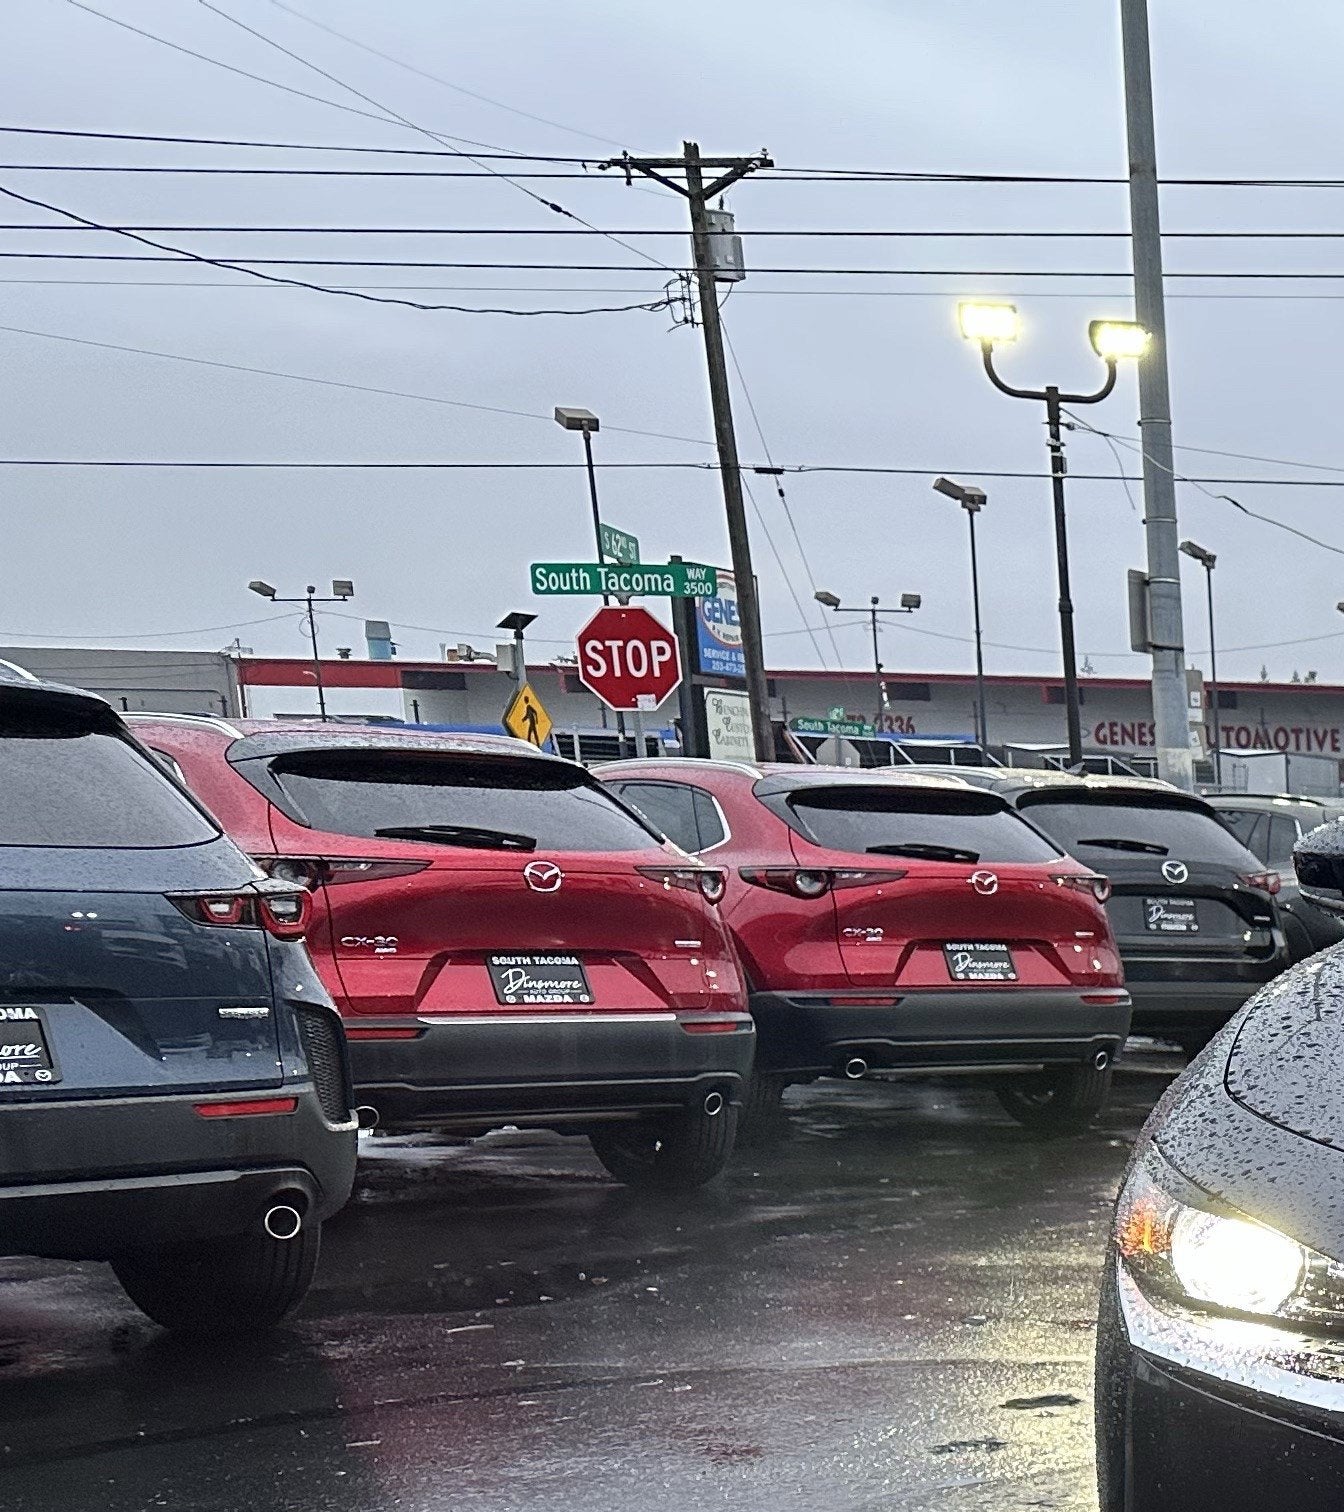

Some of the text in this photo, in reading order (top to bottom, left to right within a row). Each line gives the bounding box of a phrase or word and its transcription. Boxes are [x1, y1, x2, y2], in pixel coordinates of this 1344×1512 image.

[604, 531, 610, 550] S
[535, 567, 675, 592] South Tacoma
[686, 568, 707, 580] WAY
[683, 582, 713, 595] 3500
[585, 639, 672, 678] STOP
[1094, 721, 1156, 746] GENES
[1205, 724, 1340, 752] UTOMOTIVE
[491, 956, 579, 965] SOUTH TACOMA
[501, 967, 582, 994] Dinsmore
[523, 994, 574, 1003] MAZDA
